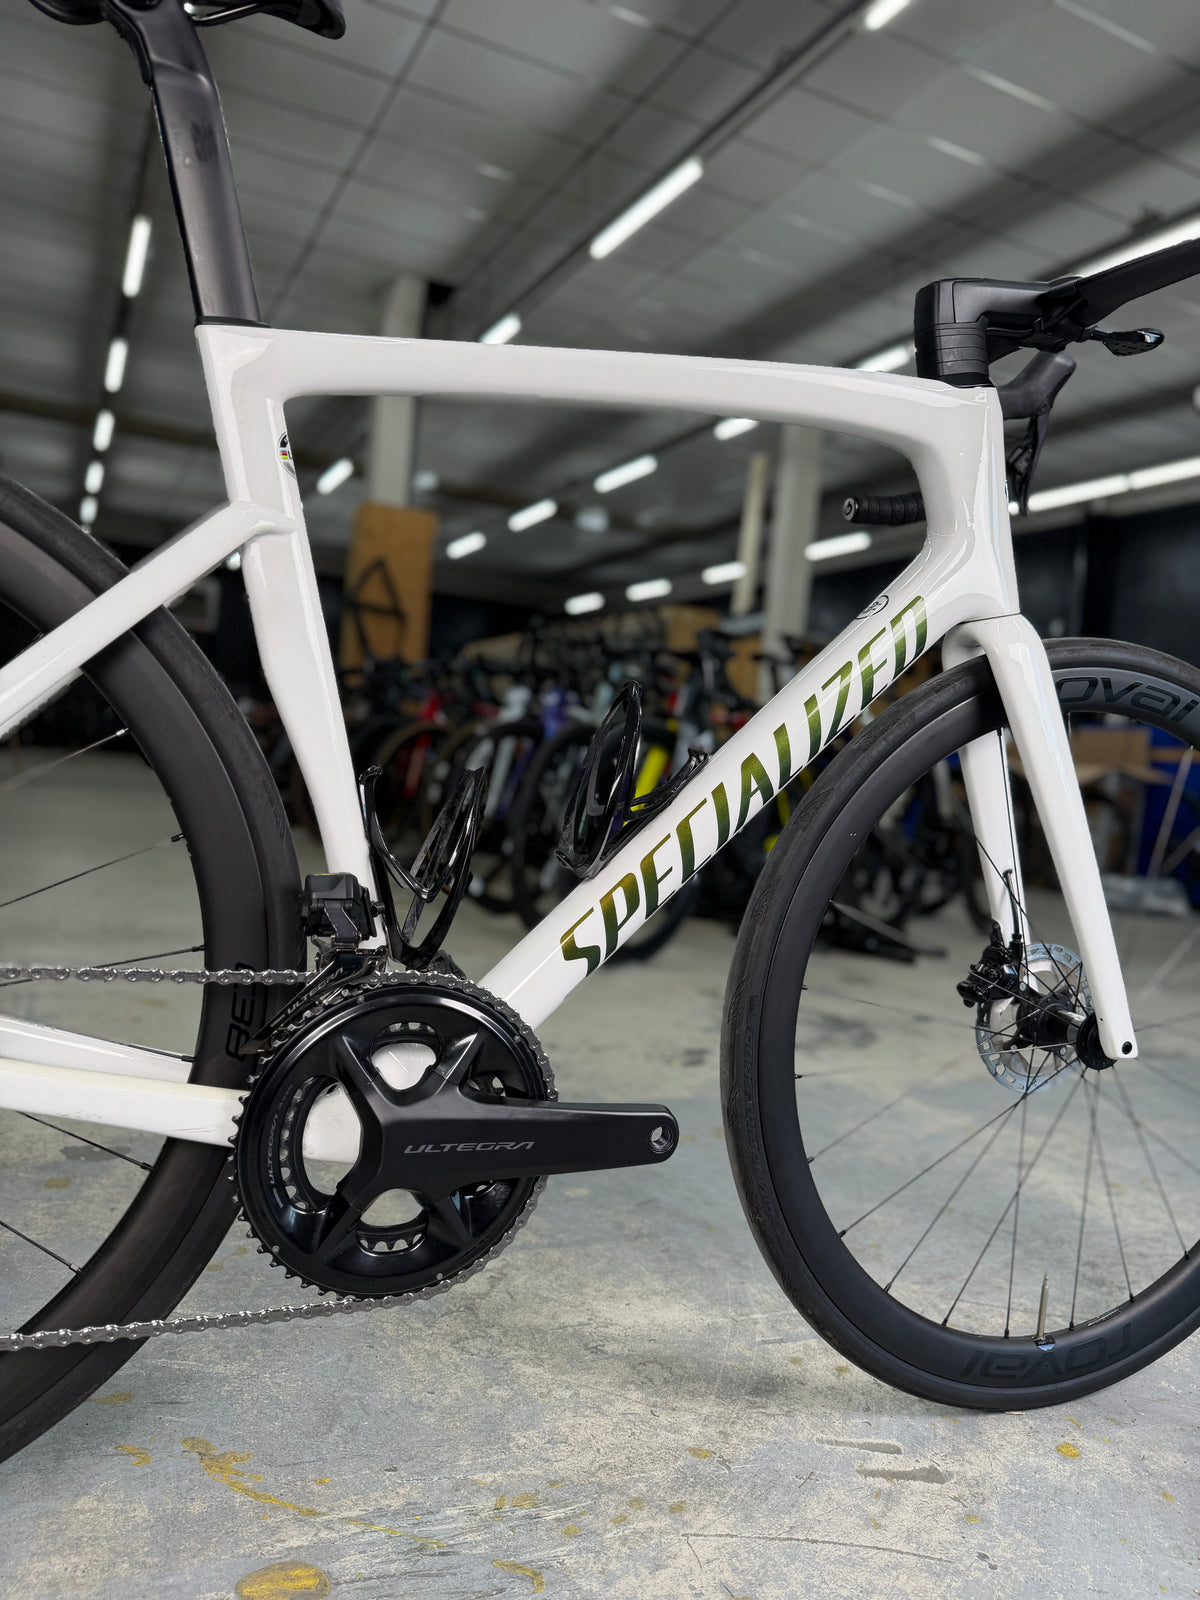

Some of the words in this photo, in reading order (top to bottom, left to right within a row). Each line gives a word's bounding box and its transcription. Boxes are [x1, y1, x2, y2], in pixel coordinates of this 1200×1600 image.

[1055, 676, 1200, 722] oval
[560, 595, 928, 976] SPECIALIZED
[403, 1141, 536, 1154] ULTEGRA
